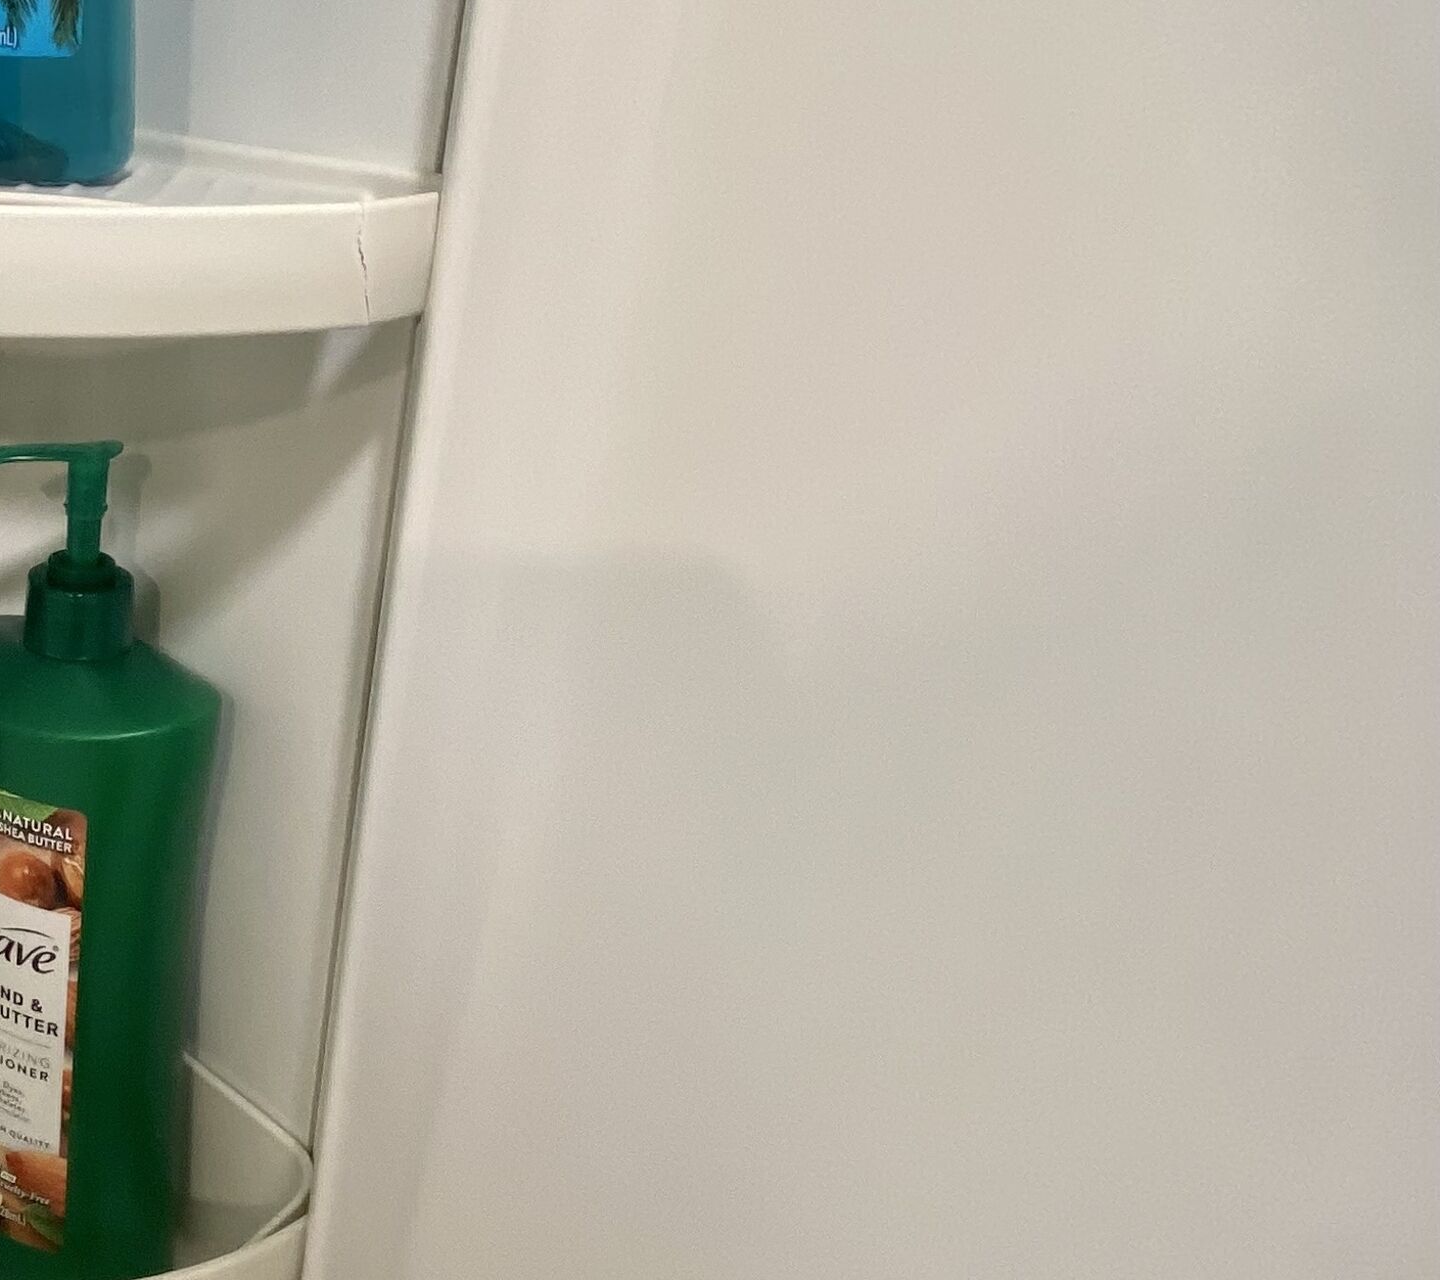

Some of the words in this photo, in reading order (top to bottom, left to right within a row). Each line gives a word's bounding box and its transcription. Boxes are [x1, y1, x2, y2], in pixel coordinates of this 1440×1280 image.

[3, 809, 73, 840] NATURAL
[28, 832, 73, 853] BUTTER
[31, 999, 42, 1013] &
[10, 1129, 50, 1150] QUALITY
